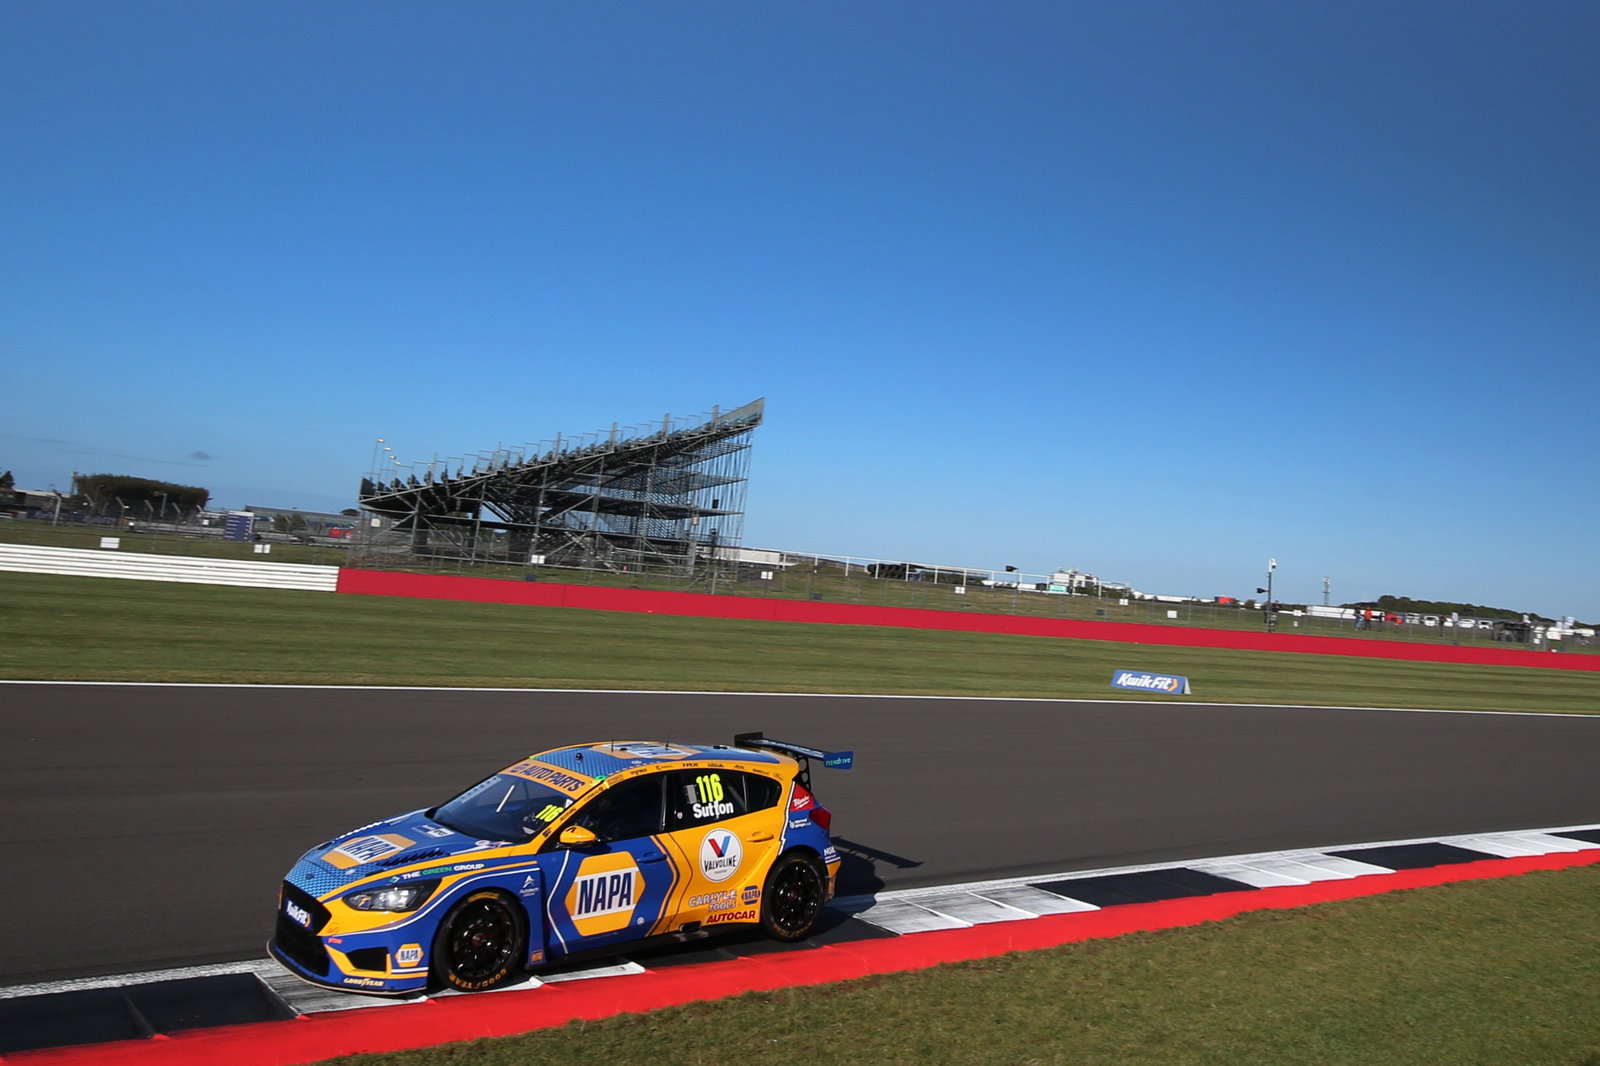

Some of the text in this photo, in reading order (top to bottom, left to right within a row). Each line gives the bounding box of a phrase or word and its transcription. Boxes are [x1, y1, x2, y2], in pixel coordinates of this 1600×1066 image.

[521, 764, 553, 780] AUTO
[547, 771, 585, 792] PARTS
[696, 773, 724, 804] 116
[693, 802, 734, 820] Sutton
[402, 863, 485, 880] THE GREEN GROUP
[704, 855, 737, 872] VALVOLINE
[578, 872, 632, 915] NAPA
[689, 890, 737, 907] CARLYLE
[708, 900, 737, 912] TOOLS
[706, 910, 756, 924] AUTOCAR
[400, 949, 419, 961] NAPA
